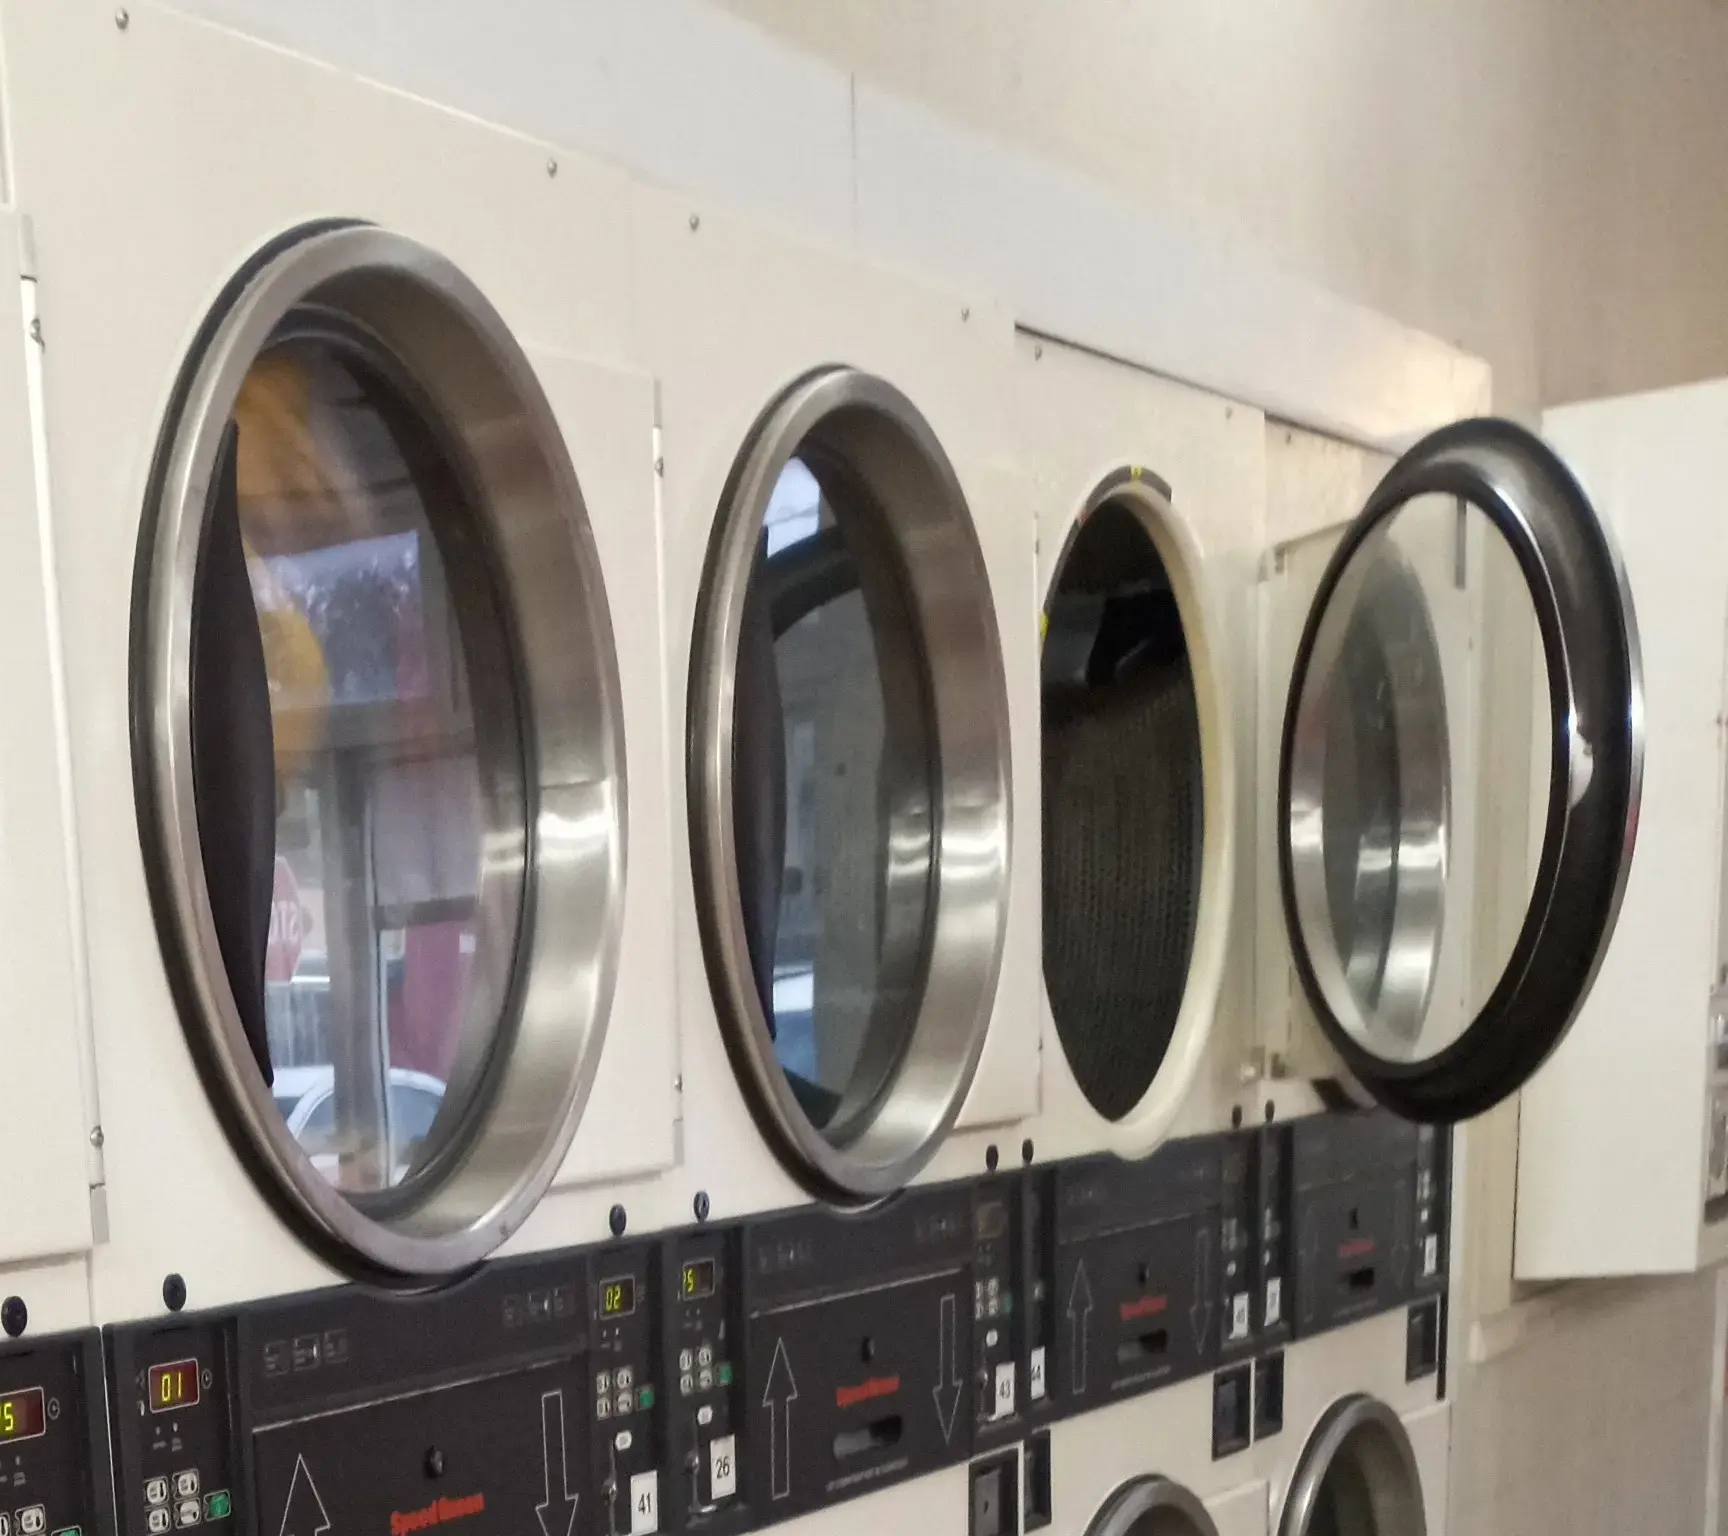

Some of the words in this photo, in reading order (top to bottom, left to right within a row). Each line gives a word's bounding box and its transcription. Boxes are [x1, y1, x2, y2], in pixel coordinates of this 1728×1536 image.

[606, 1284, 621, 1311] 02
[161, 1372, 182, 1402] 01
[715, 1456, 730, 1479] 26
[638, 1492, 651, 1515] 41
